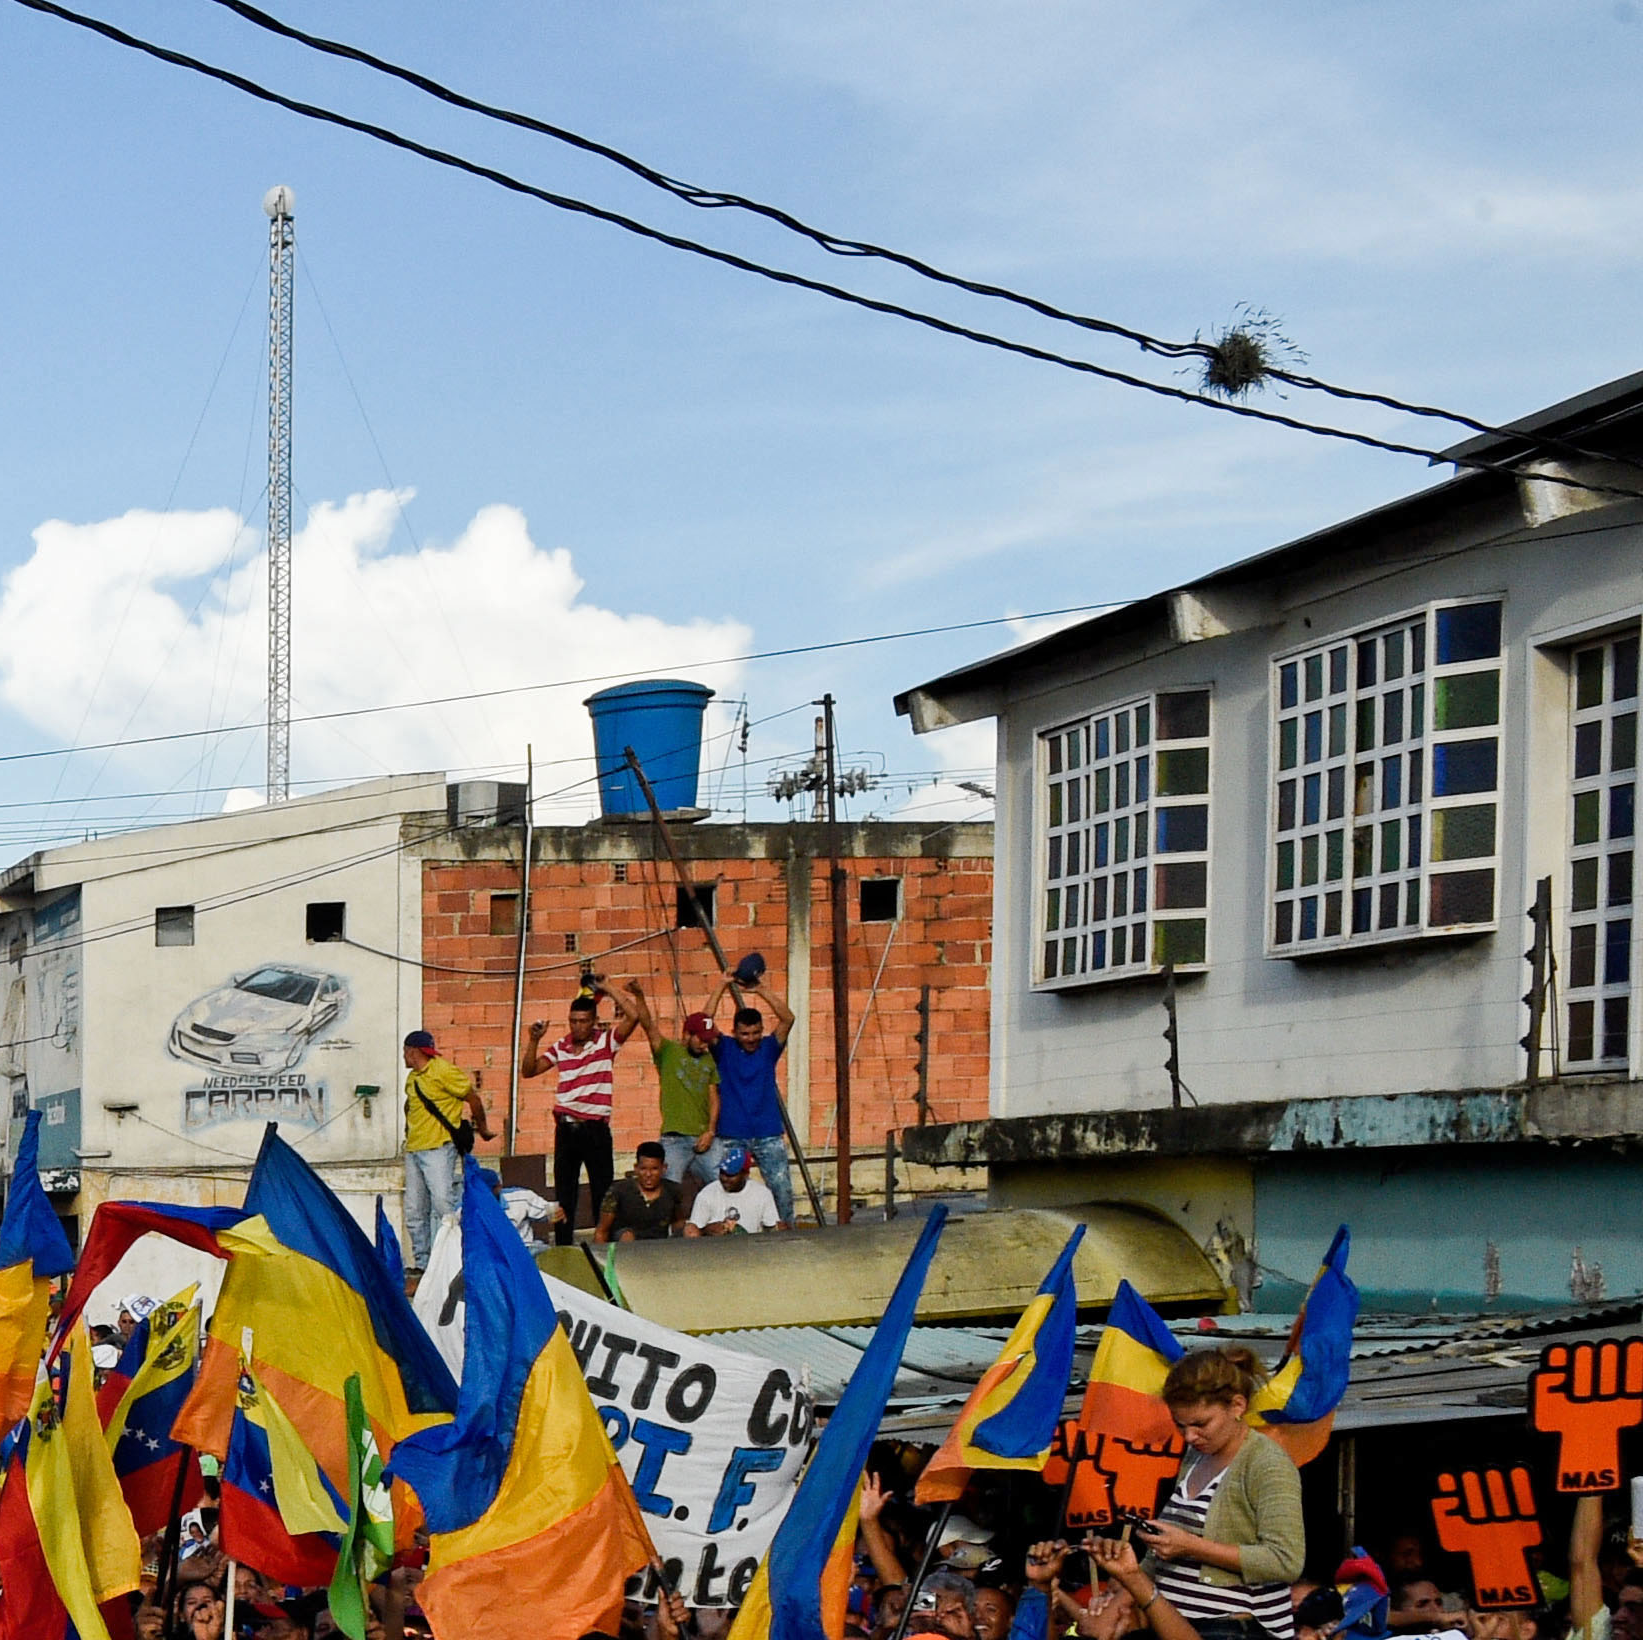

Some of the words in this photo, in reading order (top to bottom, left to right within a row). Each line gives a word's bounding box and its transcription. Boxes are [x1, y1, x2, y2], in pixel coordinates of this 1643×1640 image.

[203, 1077, 237, 1088] NEED
[259, 1074, 306, 1087] SPEED
[185, 1088, 323, 1127] CARBON
[1563, 1469, 1615, 1488] MAS
[1068, 1509, 1109, 1524] MAS
[1480, 1586, 1532, 1603] MAS
